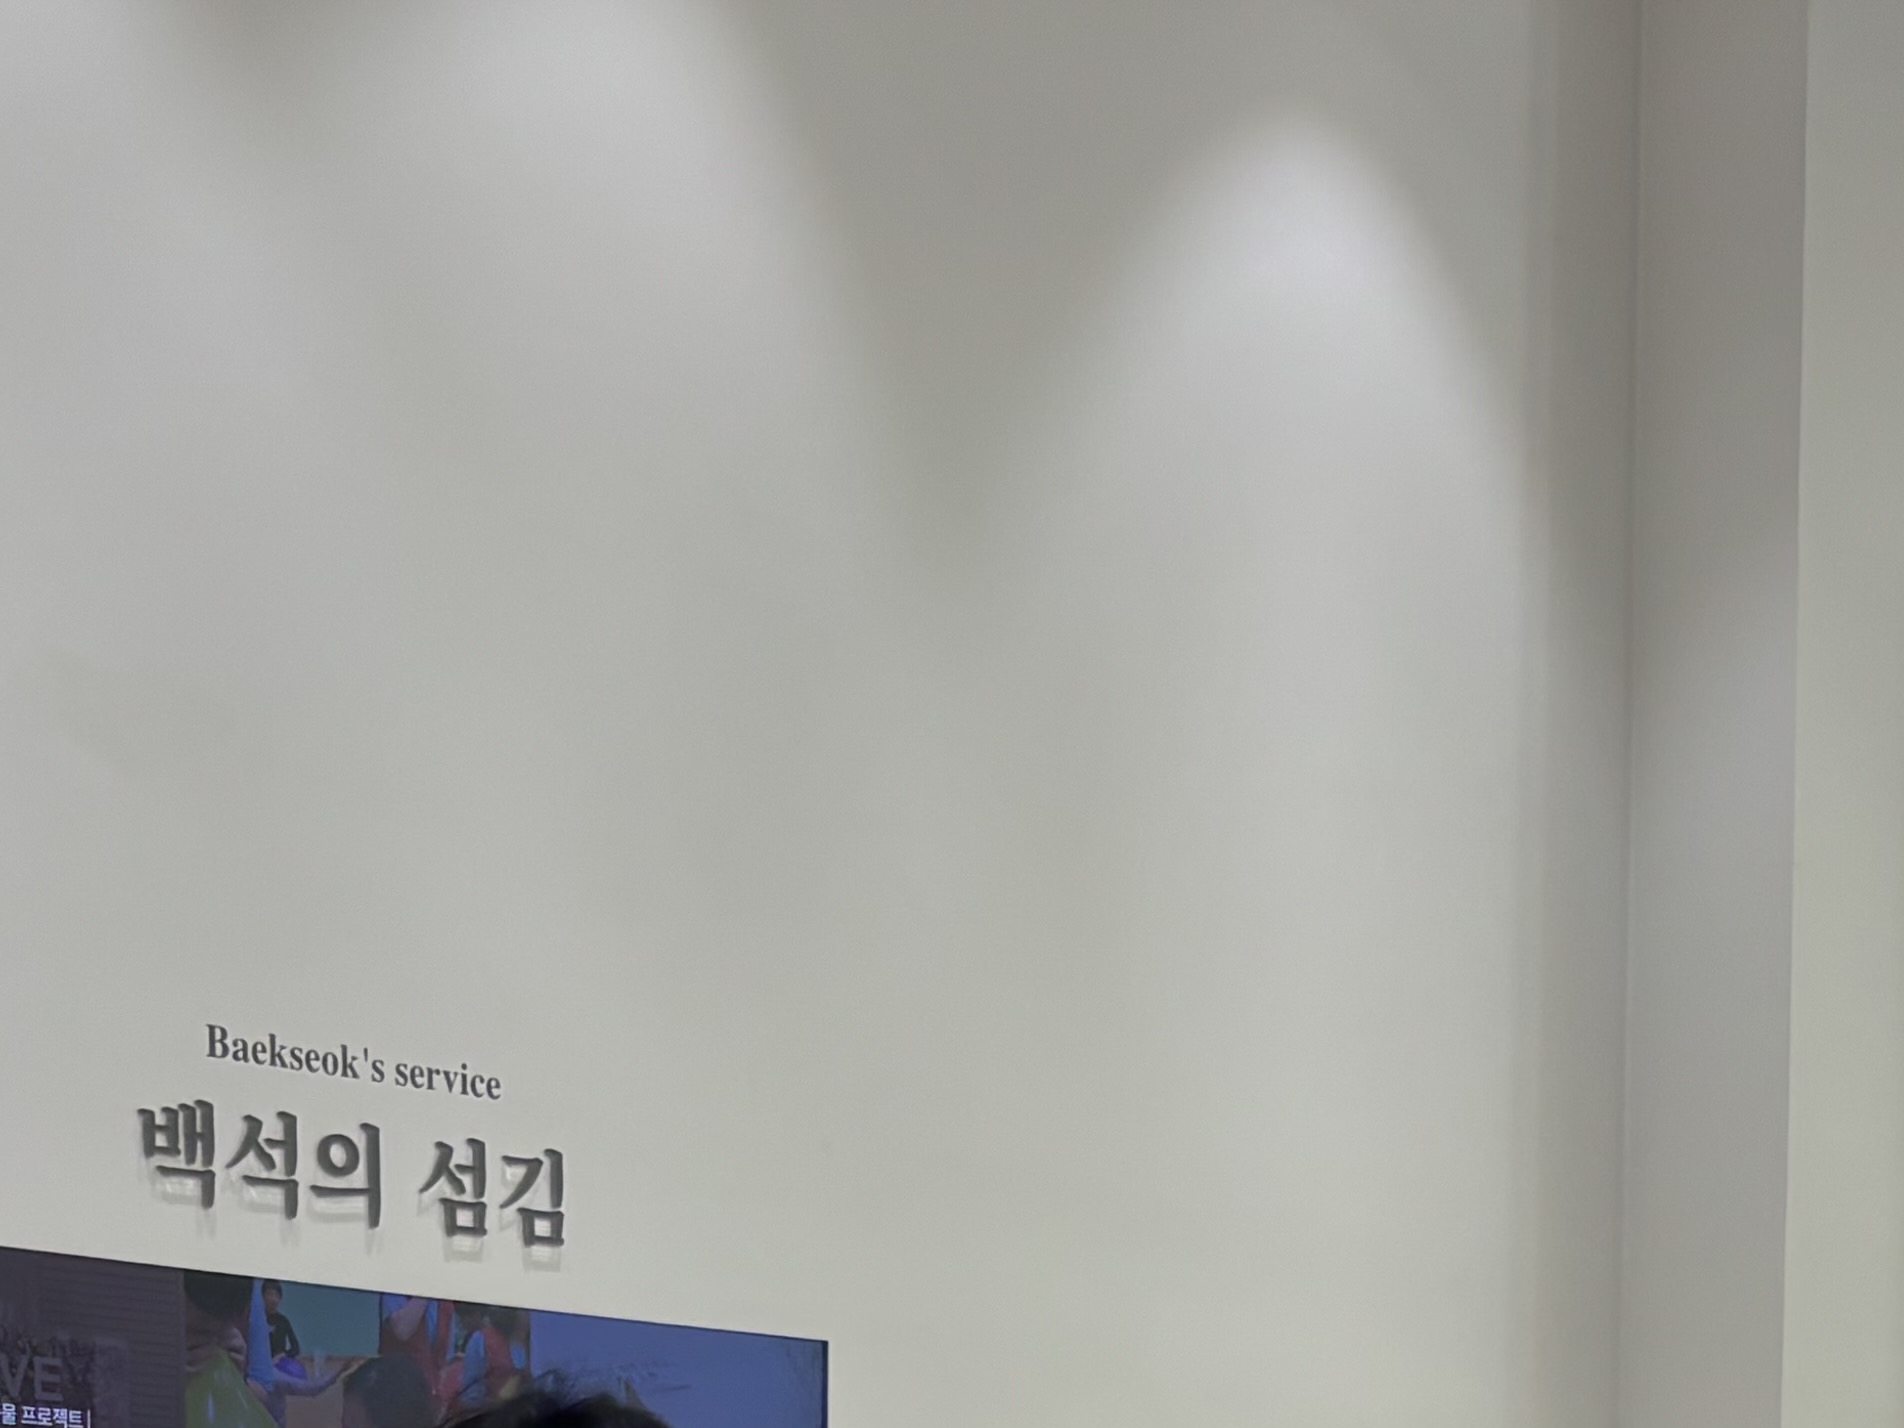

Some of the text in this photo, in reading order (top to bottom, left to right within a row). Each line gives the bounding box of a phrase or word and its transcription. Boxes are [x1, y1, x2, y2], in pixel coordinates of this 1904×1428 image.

[205, 1023, 502, 1100] Baekseok's service
[136, 1099, 565, 1247] 백석의 섬김
